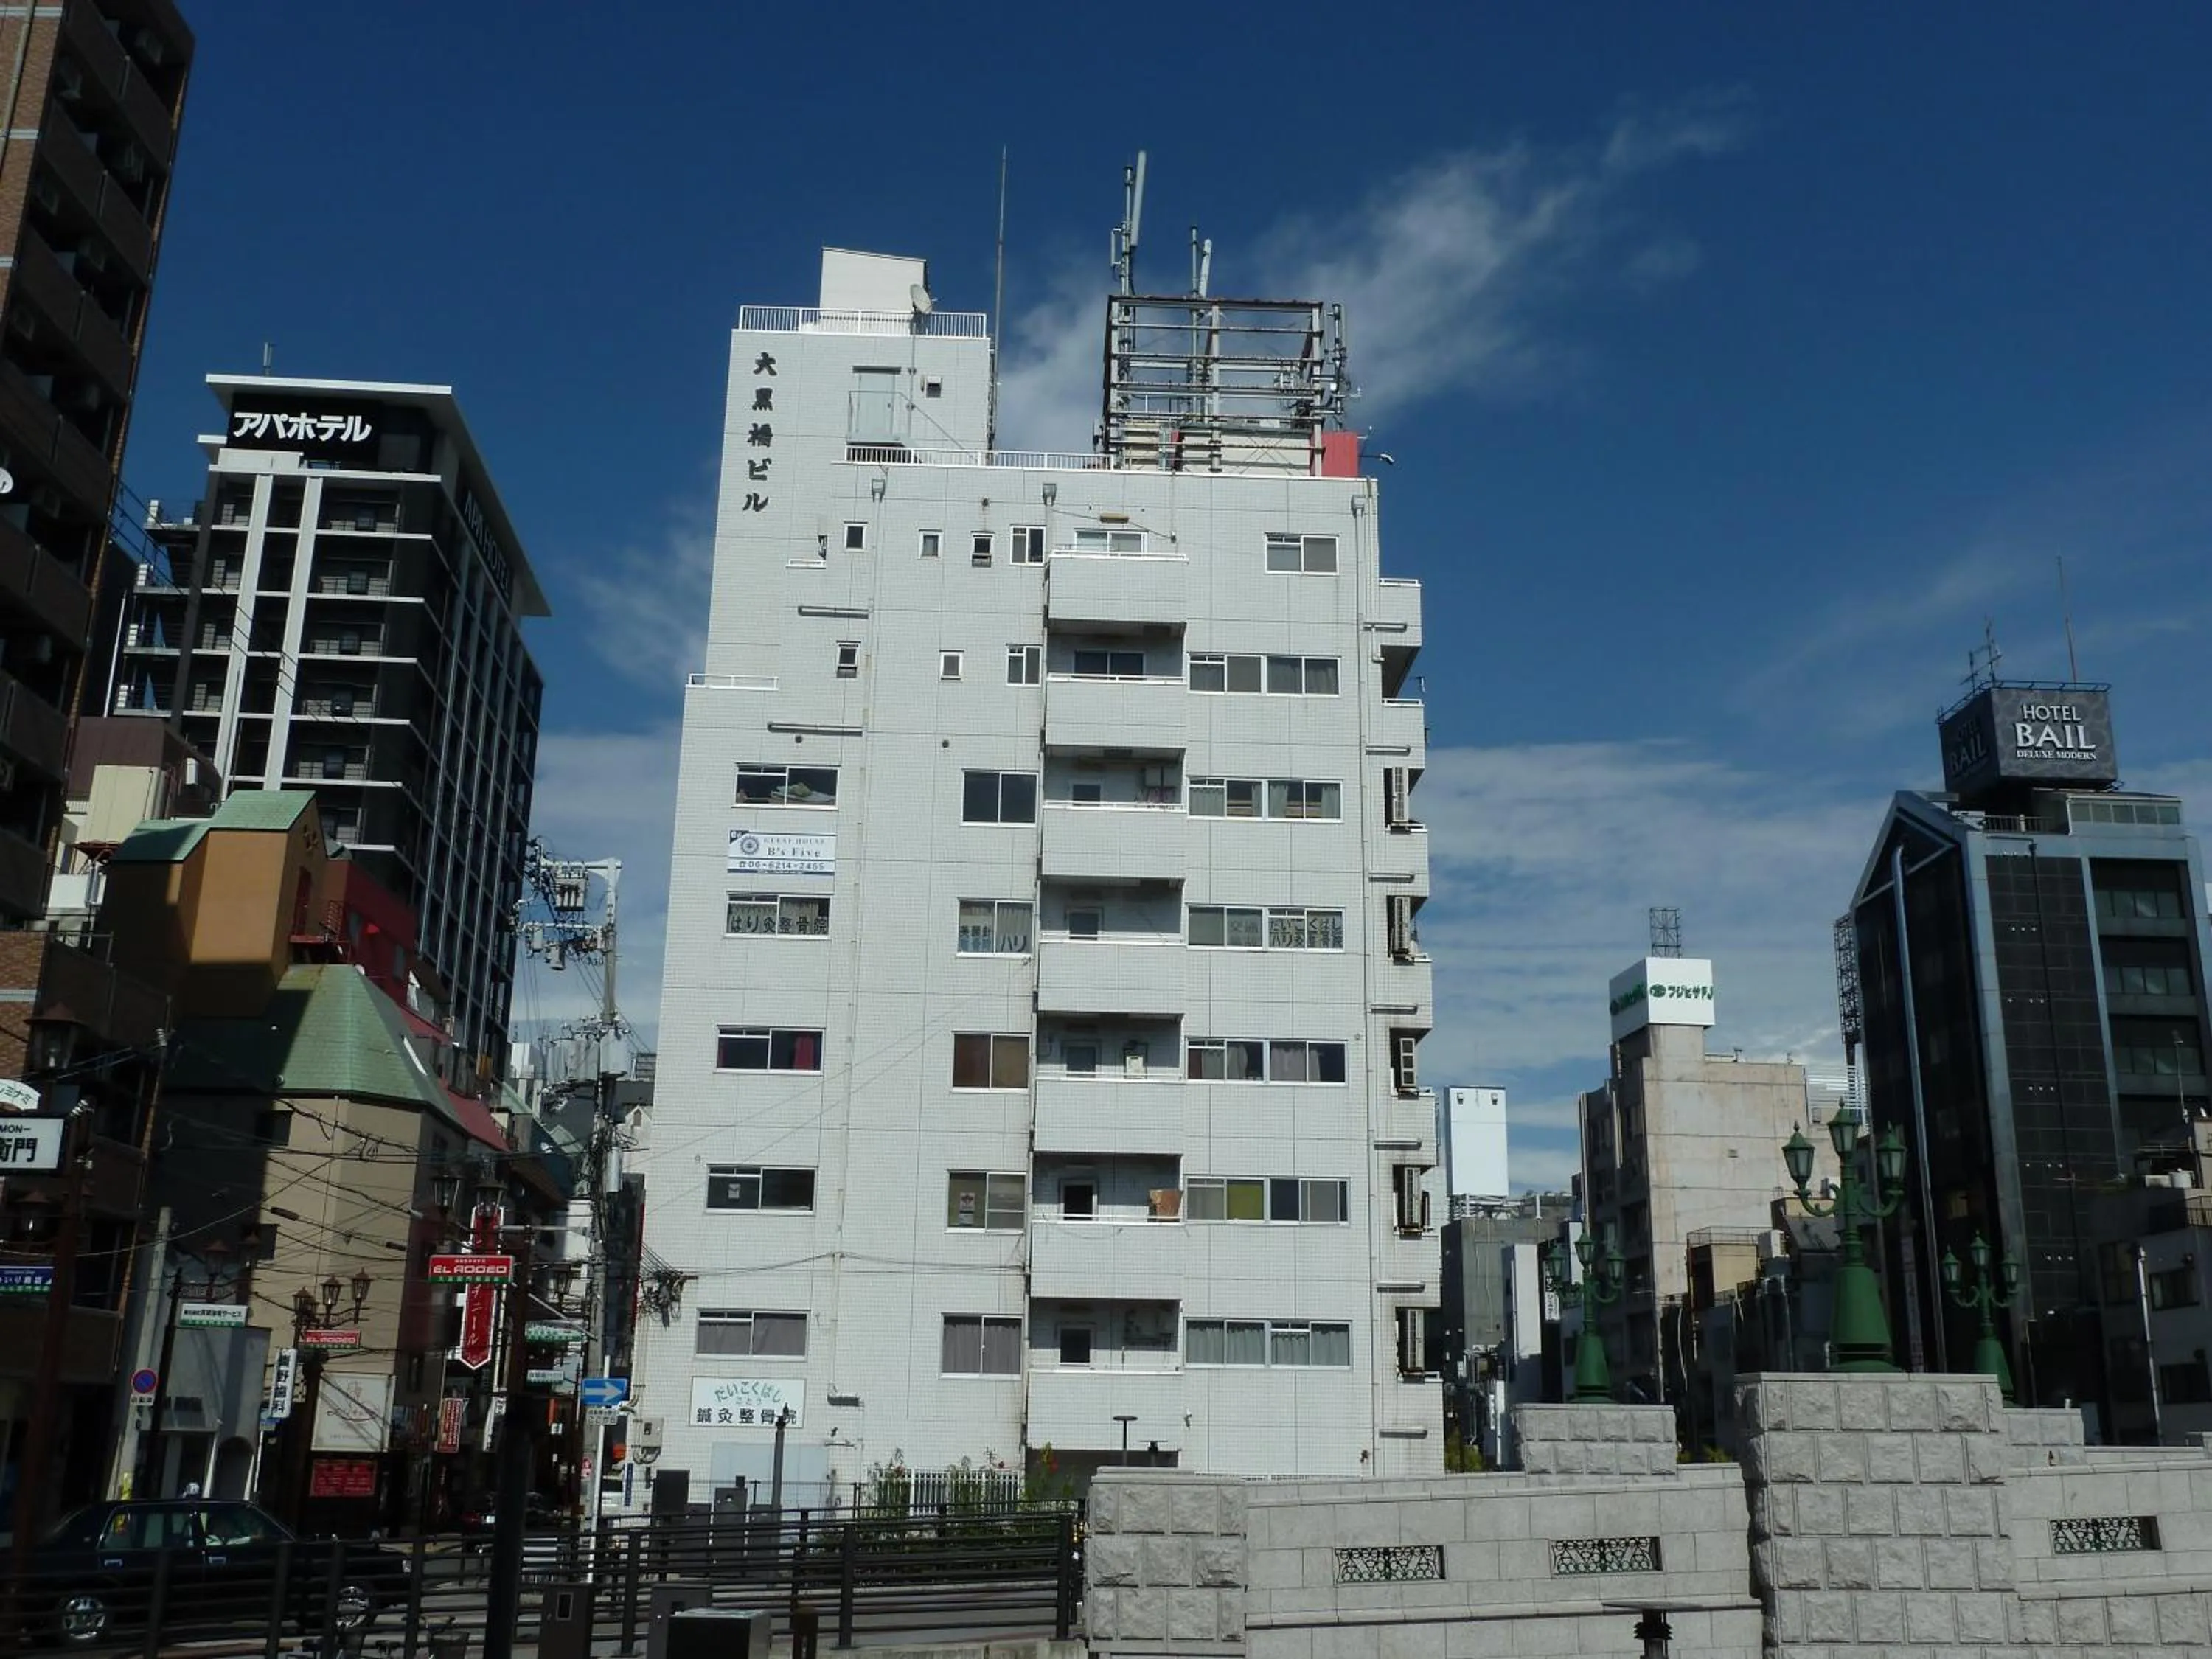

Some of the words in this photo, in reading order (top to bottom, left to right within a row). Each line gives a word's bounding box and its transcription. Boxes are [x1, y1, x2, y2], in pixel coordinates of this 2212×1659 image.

[233, 411, 372, 442] アパホテル
[742, 352, 778, 512] 大黒橋ビル
[2022, 704, 2081, 722] HOTEL
[2015, 723, 2096, 749] BAIL
[2017, 749, 2053, 759] DELUXE
[714, 1380, 783, 1402] だいこくばし
